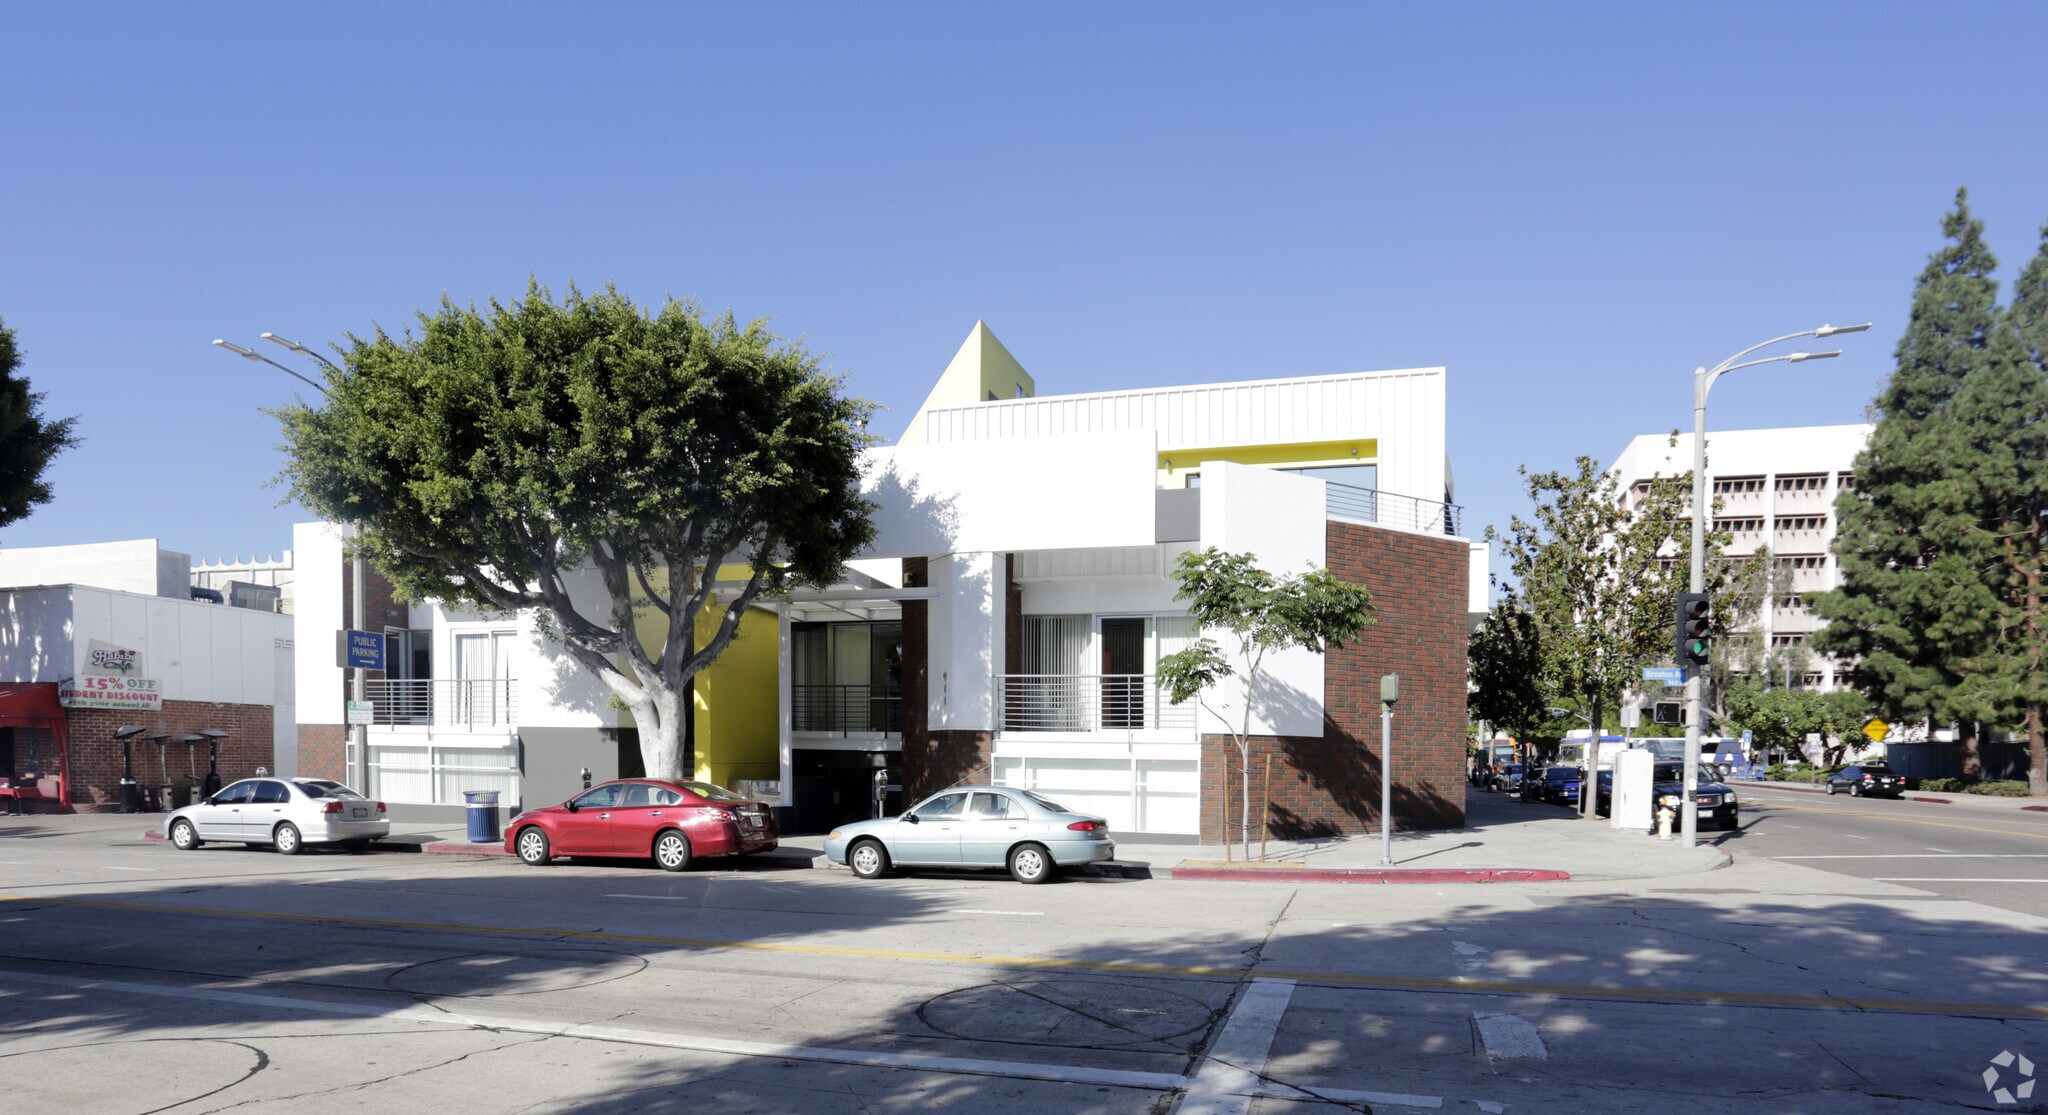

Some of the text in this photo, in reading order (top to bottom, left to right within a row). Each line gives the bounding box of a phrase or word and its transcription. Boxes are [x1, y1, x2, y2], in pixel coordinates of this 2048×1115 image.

[354, 636, 377, 647] PUBLIC
[92, 649, 136, 666] Habibi
[352, 647, 379, 658] PARKING
[1646, 670, 1673, 678] Broxton
[85, 677, 124, 690] 15%
[127, 679, 156, 689] OFF
[59, 689, 159, 702] STUDENT DISCOUNT
